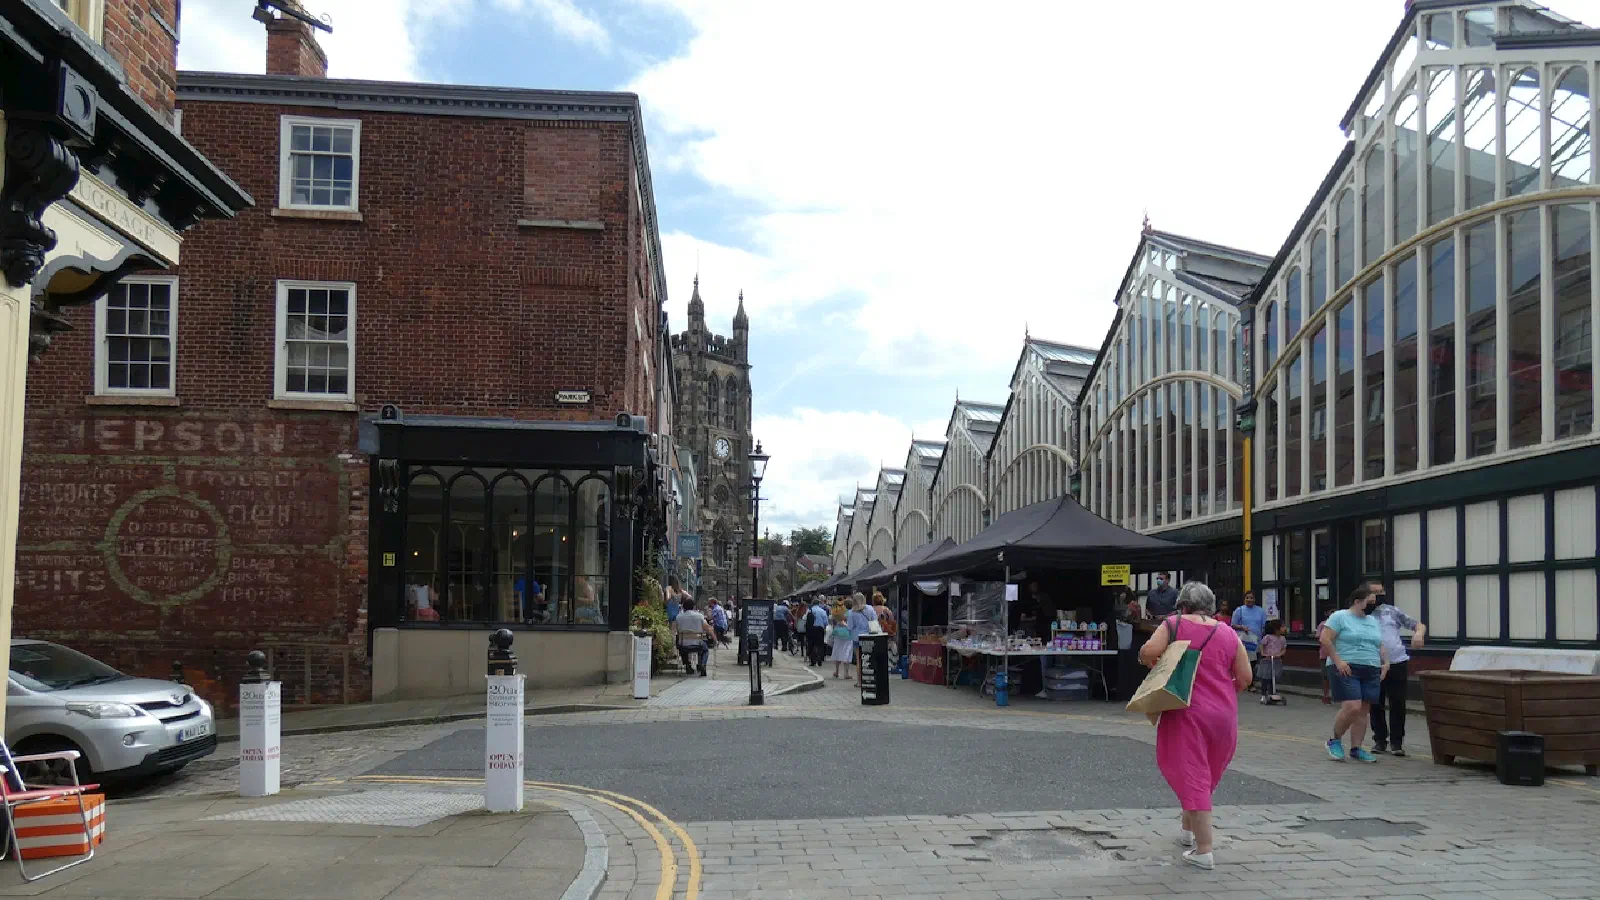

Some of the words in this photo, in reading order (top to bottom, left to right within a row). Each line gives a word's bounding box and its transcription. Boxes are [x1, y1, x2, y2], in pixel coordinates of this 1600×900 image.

[75, 179, 155, 245] UGGAGE
[384, 554, 394, 565] H
[489, 753, 515, 761] OPEN
[489, 761, 516, 770] TODAY
